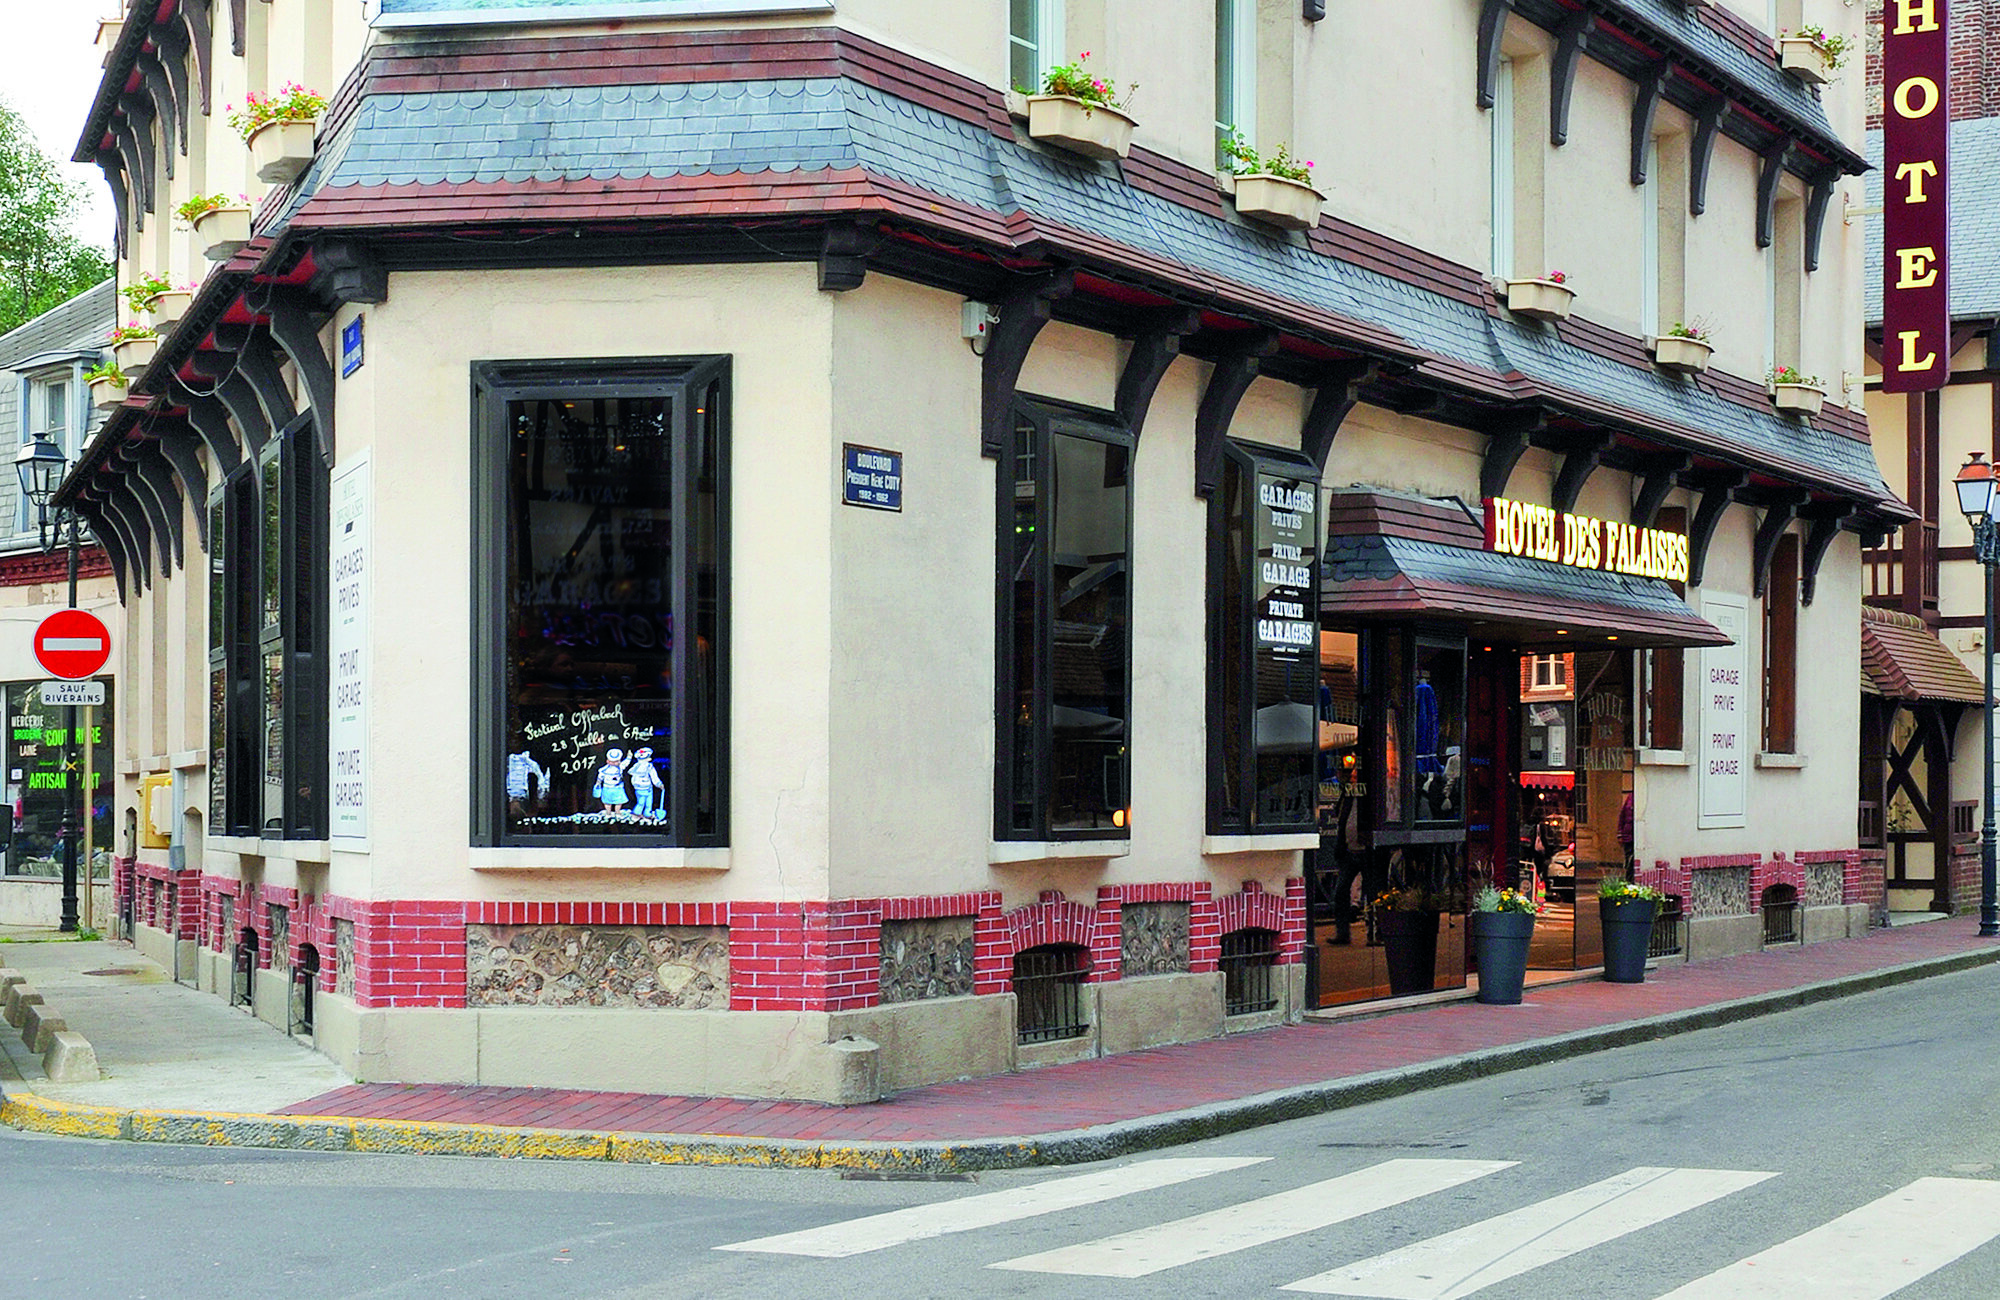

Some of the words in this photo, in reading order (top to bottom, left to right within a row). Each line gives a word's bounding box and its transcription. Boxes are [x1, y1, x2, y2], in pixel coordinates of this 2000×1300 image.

[1892, 0, 1940, 373] HOTEL
[1260, 483, 1314, 514] GARAGES
[1271, 511, 1302, 530] PRIVES
[1493, 497, 1560, 562] HOTEL
[1562, 513, 1601, 570] DES
[1605, 521, 1689, 583] FALAISES
[1272, 543, 1302, 561] PRIVAT
[335, 547, 363, 582] GARAGES
[1263, 562, 1310, 589] GARAGE
[1268, 600, 1304, 619] PRIVATE
[1258, 619, 1313, 645] GARAGES
[1710, 668, 1740, 685] GARAGE
[45, 694, 101, 703] RIVERAINS
[60, 684, 87, 693] SAUF
[337, 681, 361, 708] GARAGE
[1713, 695, 1735, 711] PRIVE
[524, 713, 566, 740] Festival
[571, 703, 631, 734] Offenbach
[552, 740, 568, 752] 28
[570, 731, 605, 758] Juillet
[623, 726, 631, 739] 6
[1712, 733, 1736, 749] PRIVAT
[337, 750, 360, 776] PRIVATE
[561, 756, 597, 774] 2017
[1710, 760, 1739, 775] GARAGE
[29, 772, 67, 789] ARTISAN
[335, 782, 363, 806] GARAGES
